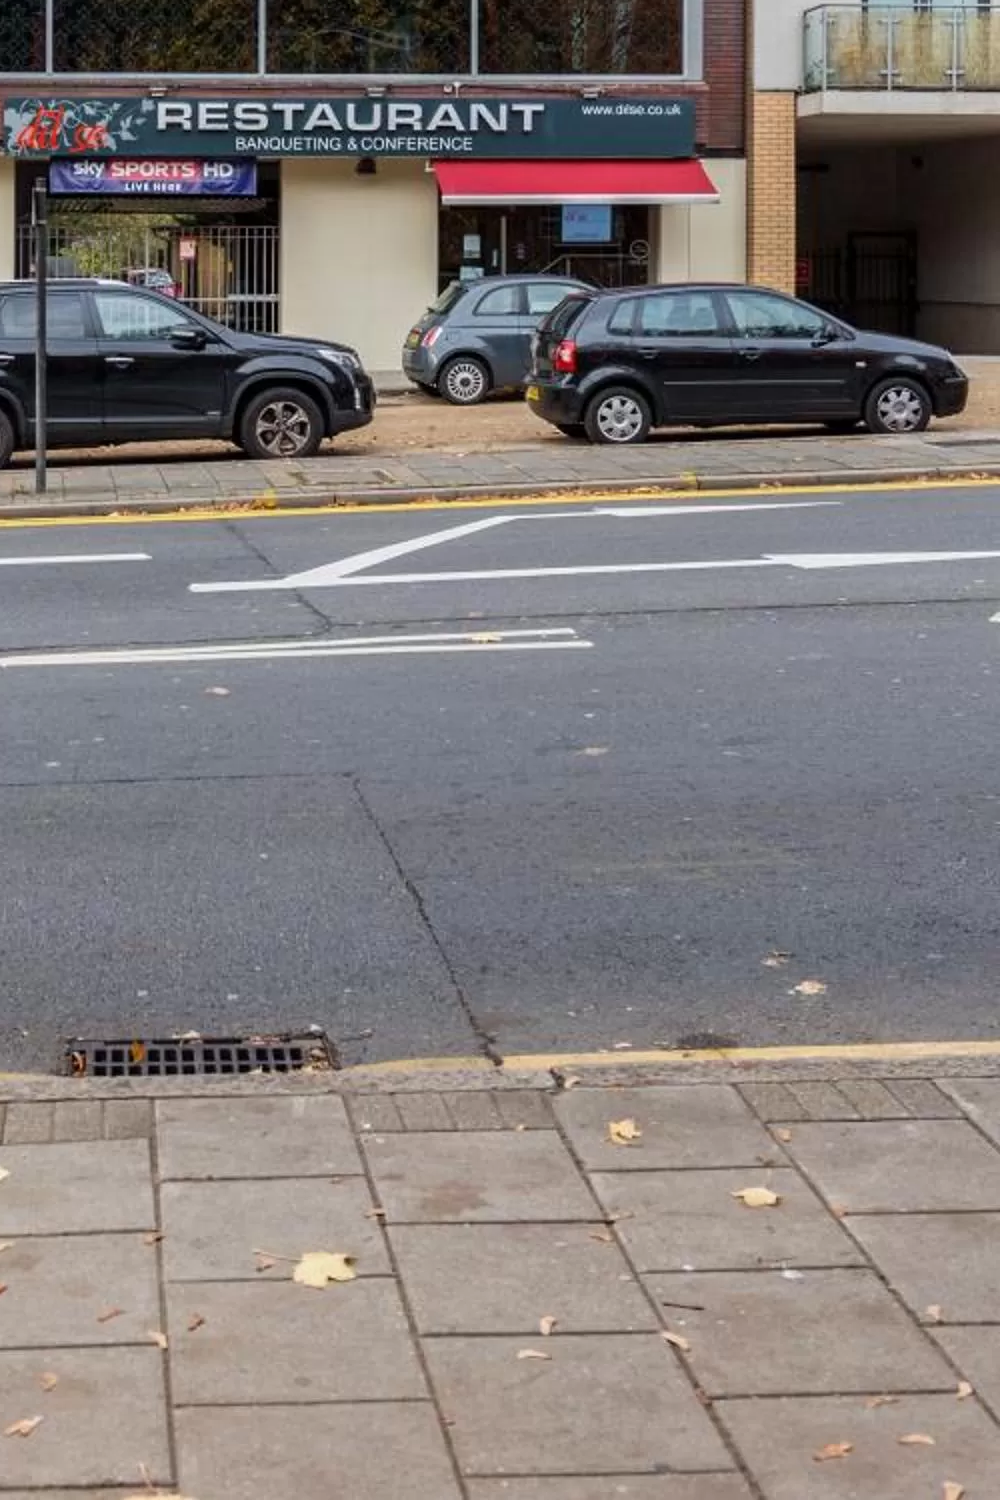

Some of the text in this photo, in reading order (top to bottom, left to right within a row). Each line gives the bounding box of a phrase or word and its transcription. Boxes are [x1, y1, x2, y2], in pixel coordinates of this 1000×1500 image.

[156, 101, 545, 132] RESTAURANT
[235, 136, 473, 151] BANQUETING & CONFERENCE
[73, 159, 234, 178] sky SPORTS HD
[124, 181, 182, 192] LIVE HERE
